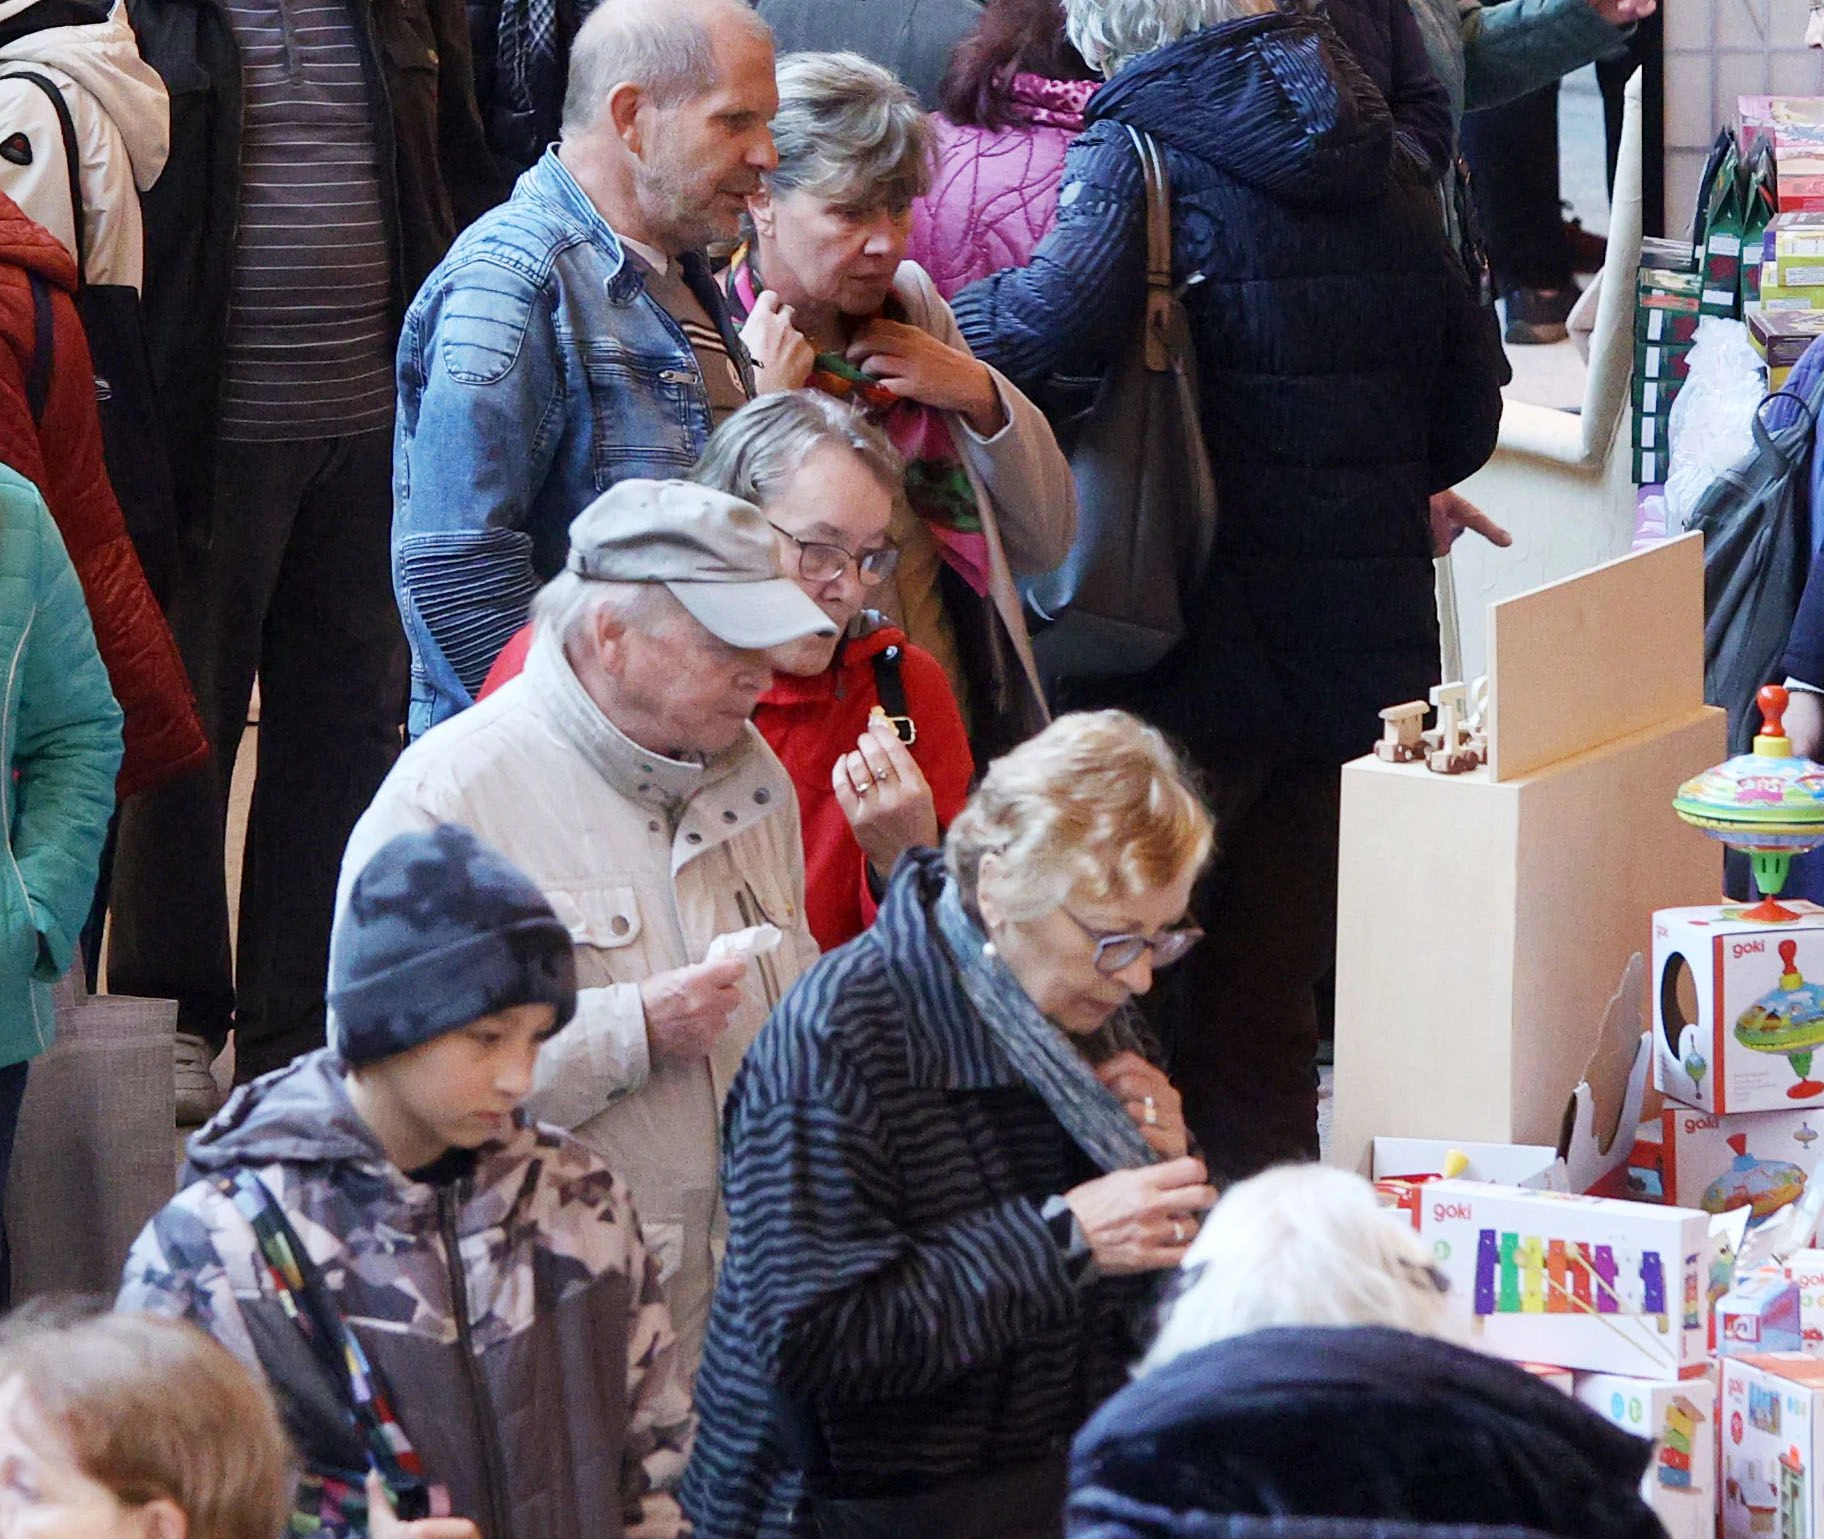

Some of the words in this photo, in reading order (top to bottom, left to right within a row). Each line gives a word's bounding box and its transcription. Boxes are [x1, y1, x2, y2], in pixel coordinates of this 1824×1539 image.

[1732, 939, 1766, 958] goki
[1684, 1115, 1720, 1134] goki
[1432, 1203, 1472, 1222] goki
